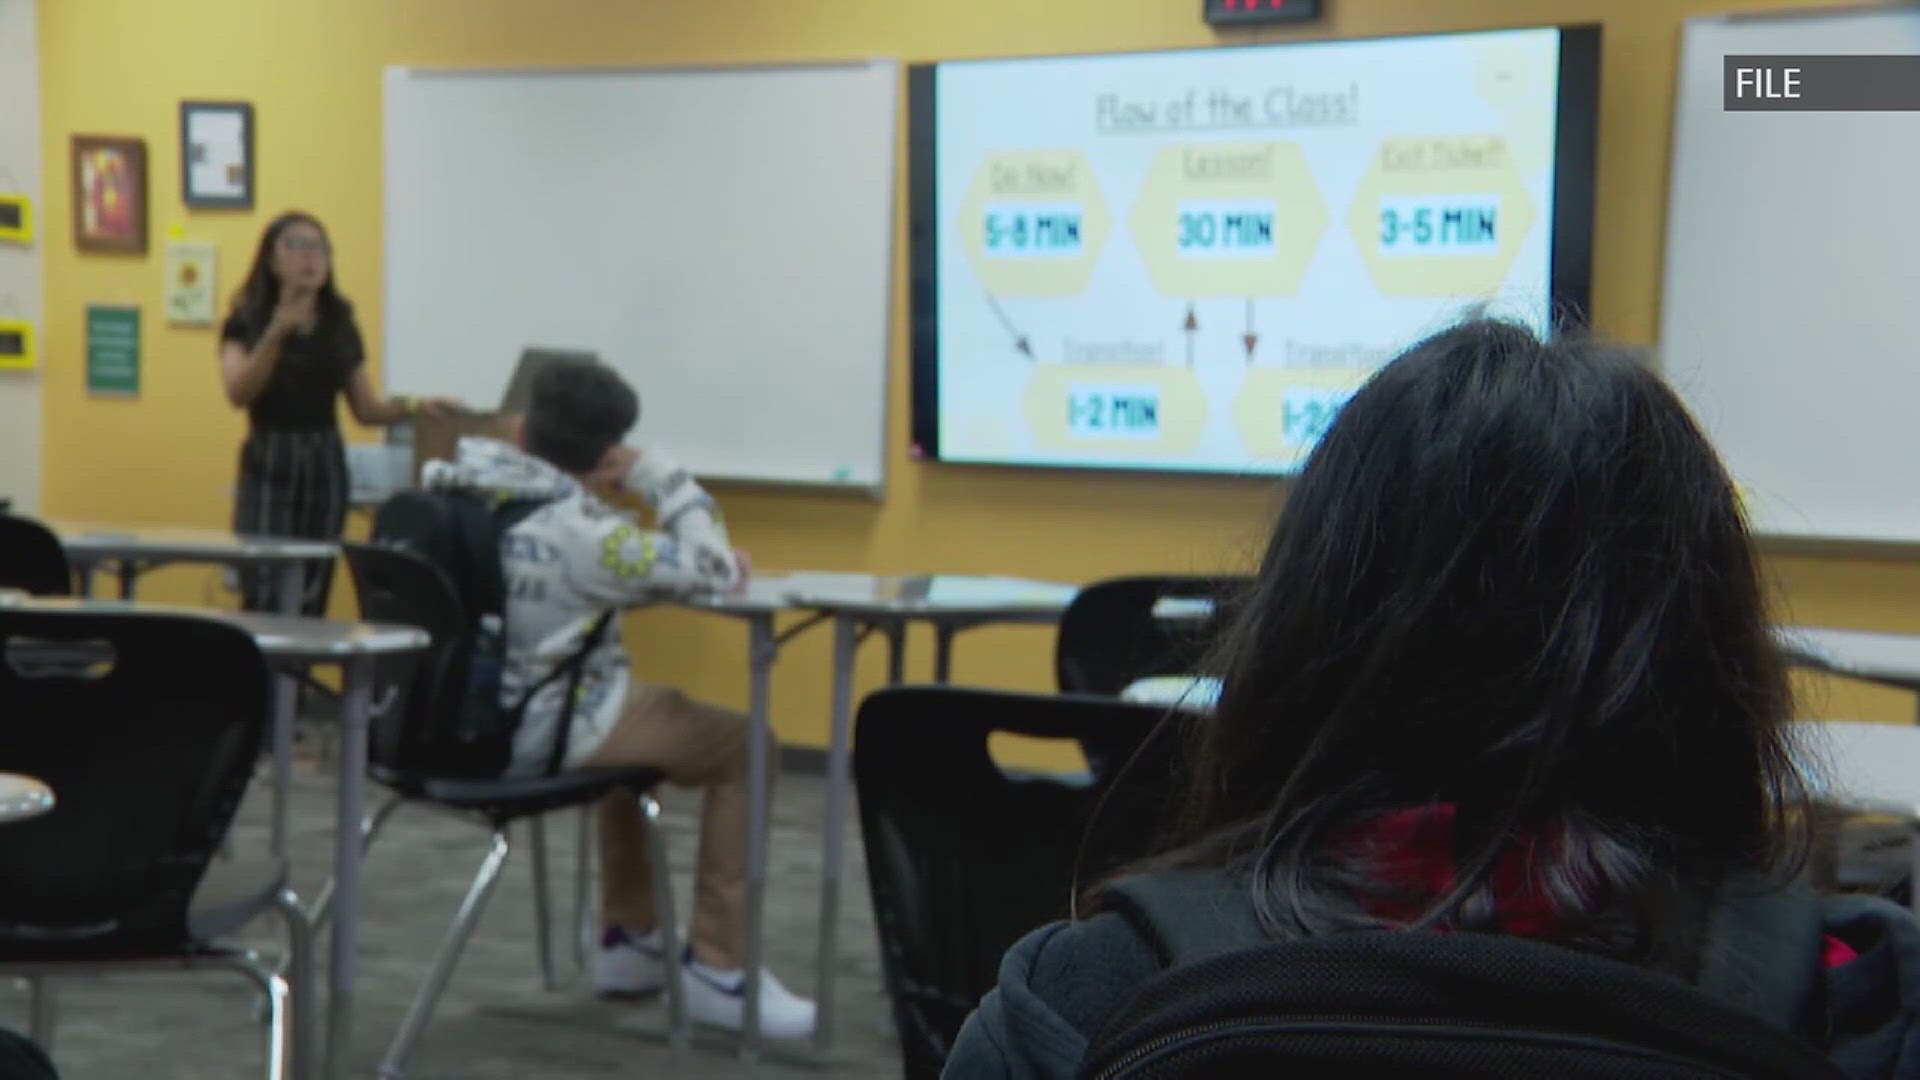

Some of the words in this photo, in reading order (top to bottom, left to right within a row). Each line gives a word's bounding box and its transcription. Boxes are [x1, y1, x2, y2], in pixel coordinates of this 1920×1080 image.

[1095, 92, 1156, 126] Flow
[1164, 87, 1197, 125] of
[1207, 85, 1252, 123] the
[1263, 81, 1360, 123] Class!
[985, 213, 1028, 248] 5-8
[1035, 213, 1081, 247] MIN
[1179, 211, 1216, 247] 30
[1222, 211, 1273, 246] MIN
[1381, 207, 1433, 245] 3-5
[1441, 206, 1497, 245] MIN
[1067, 395, 1104, 428] 1-2
[1111, 394, 1159, 428] MIN
